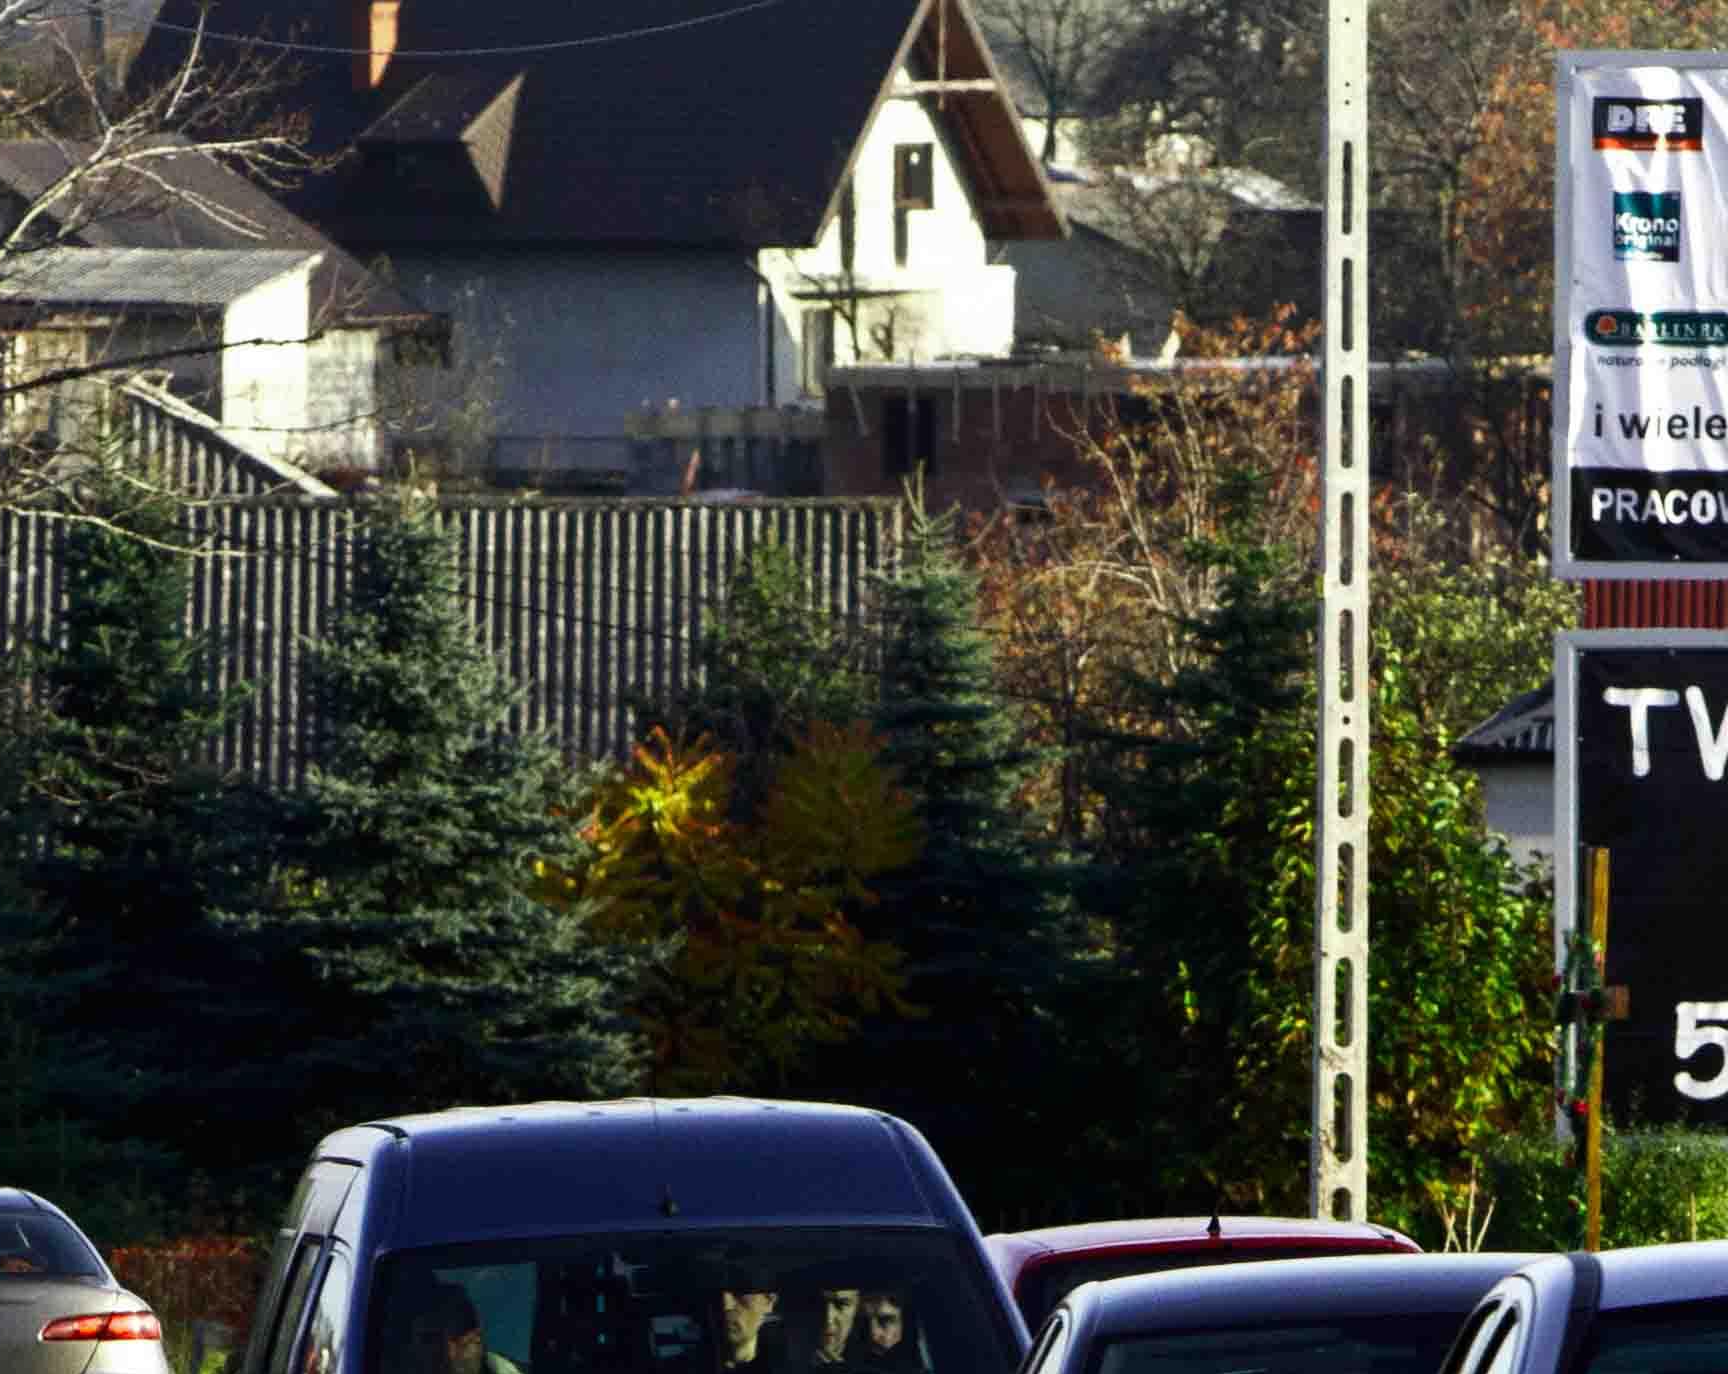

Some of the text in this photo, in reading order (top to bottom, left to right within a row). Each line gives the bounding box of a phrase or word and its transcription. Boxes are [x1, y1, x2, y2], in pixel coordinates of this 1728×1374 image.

[1616, 212, 1678, 233] Krono
[1594, 403, 1603, 438] i
[1619, 404, 1727, 440] wiele
